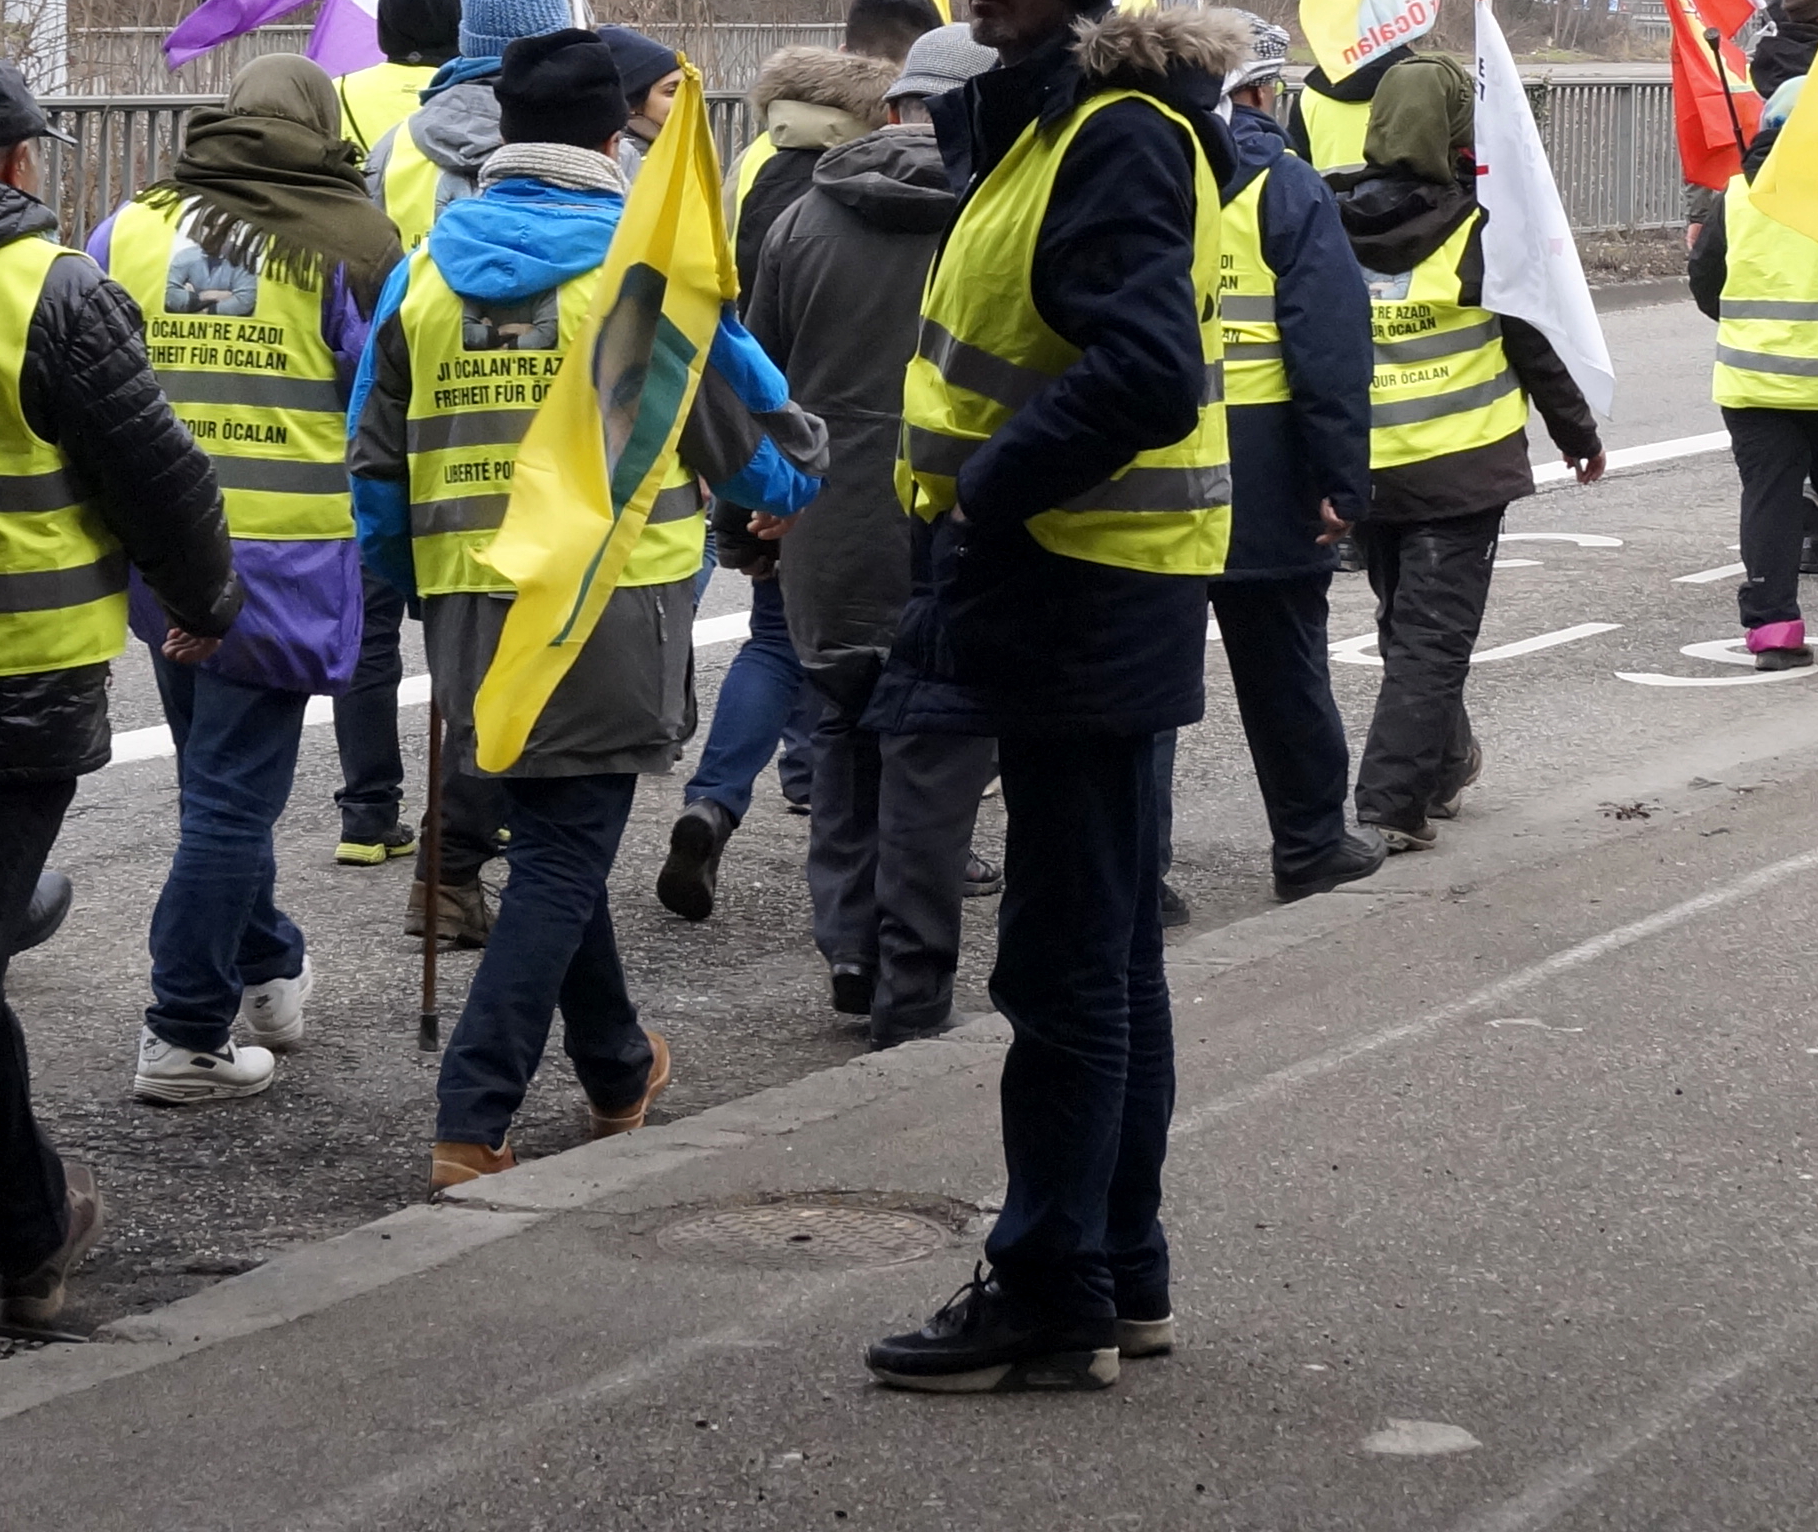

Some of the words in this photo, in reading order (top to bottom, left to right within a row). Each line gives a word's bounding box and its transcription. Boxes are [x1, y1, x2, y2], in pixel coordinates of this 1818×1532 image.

[1396, 304, 1431, 320] AZADI
[236, 323, 284, 347] AZADI
[1387, 316, 1437, 338] ÖCALAN
[146, 344, 187, 365] EIHEIT
[190, 343, 219, 366] FÜR
[224, 344, 288, 372] ÖCALAN
[437, 361, 451, 382] JI
[1372, 373, 1398, 390] OUR
[1400, 365, 1450, 385] ÖCALAN
[434, 384, 490, 409] FREIHEIT
[494, 379, 526, 404] FÜR
[181, 418, 217, 440] OUR
[222, 417, 288, 445] ÖCALAN
[444, 457, 492, 485] LIBERTÉ
